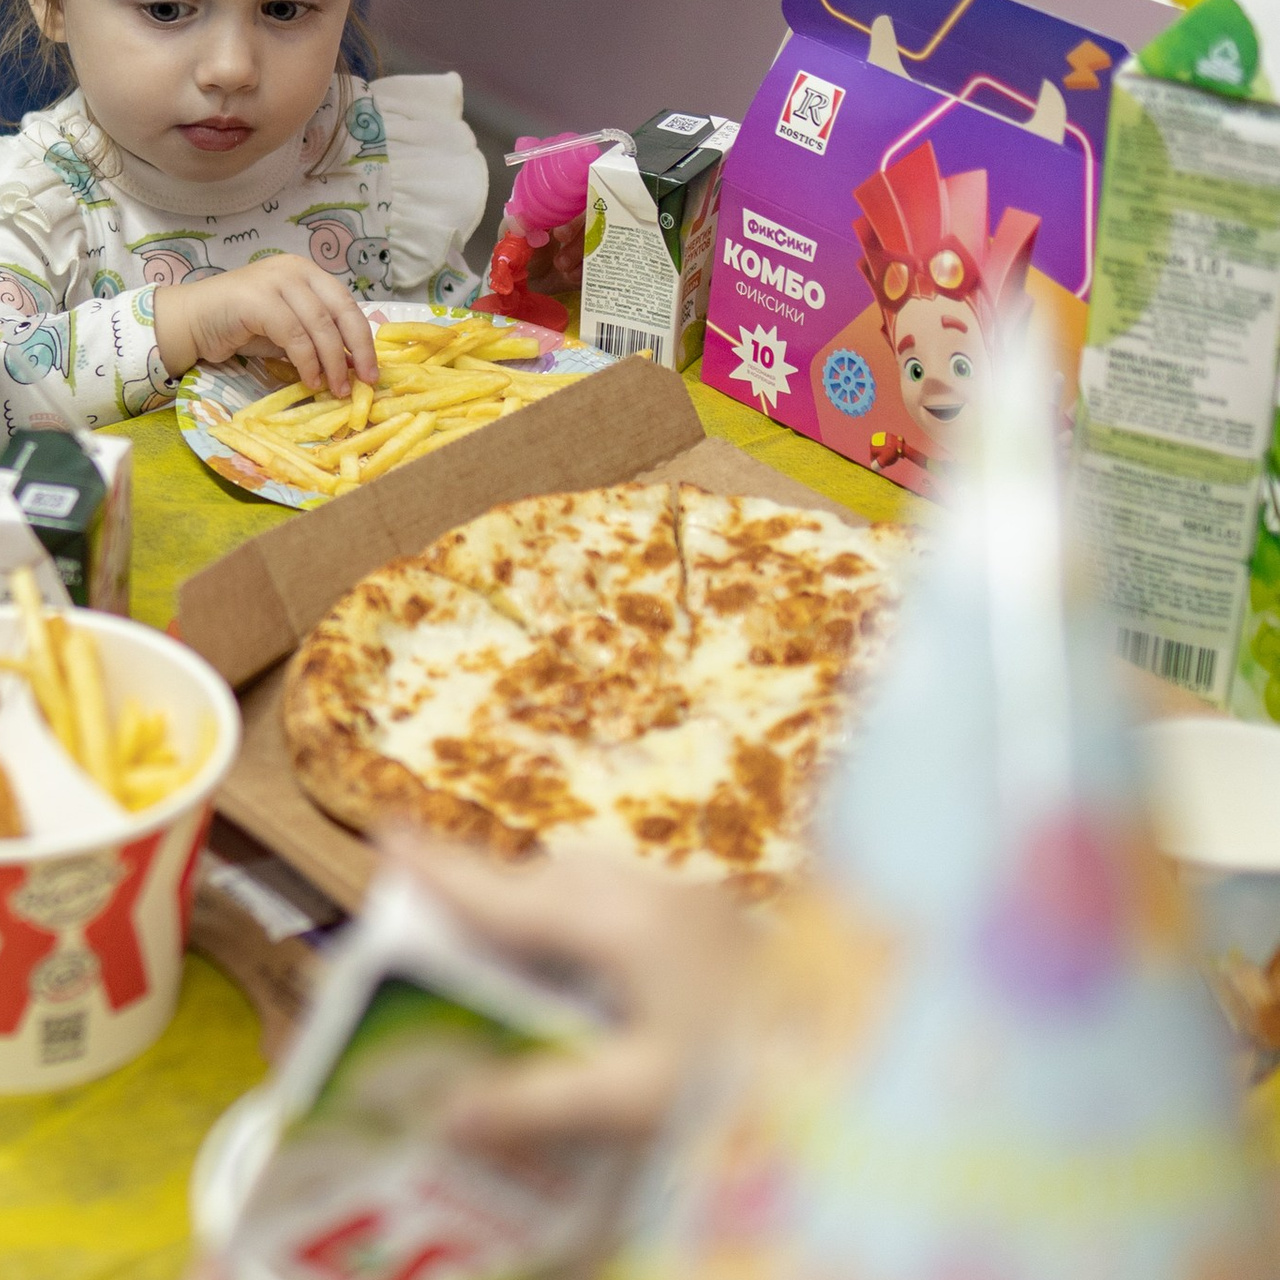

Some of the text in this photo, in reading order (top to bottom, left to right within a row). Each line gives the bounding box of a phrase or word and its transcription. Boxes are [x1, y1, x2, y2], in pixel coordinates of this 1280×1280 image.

[792, 87, 830, 127] R
[779, 124, 824, 151] ROSTIC'S
[723, 237, 826, 310] КОМБО
[735, 280, 805, 326] ФИКСИКИ
[751, 339, 775, 370] 10
